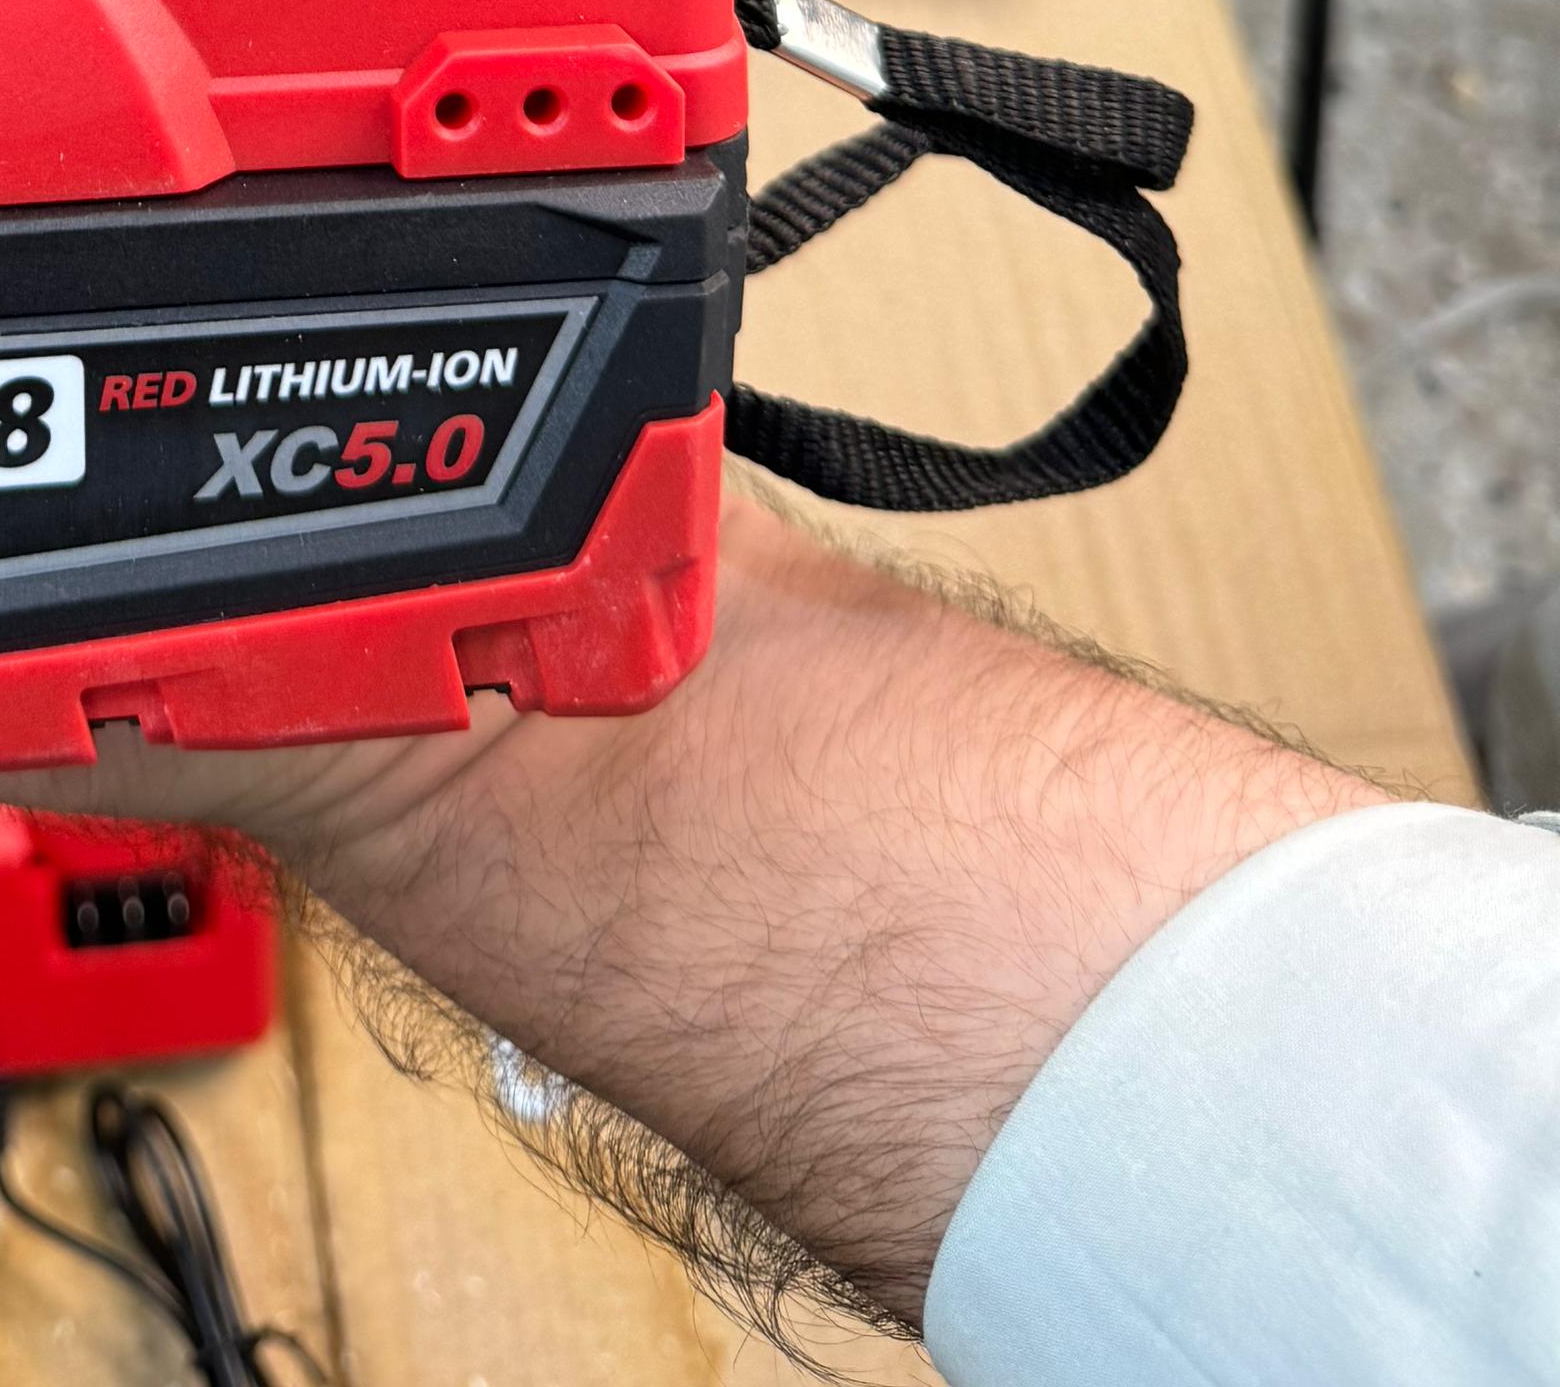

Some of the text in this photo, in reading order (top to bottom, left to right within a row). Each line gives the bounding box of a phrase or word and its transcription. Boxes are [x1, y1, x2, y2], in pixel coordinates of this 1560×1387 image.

[99, 346, 519, 412] RED LITHIUM-ION
[193, 413, 486, 503] XC5.0
